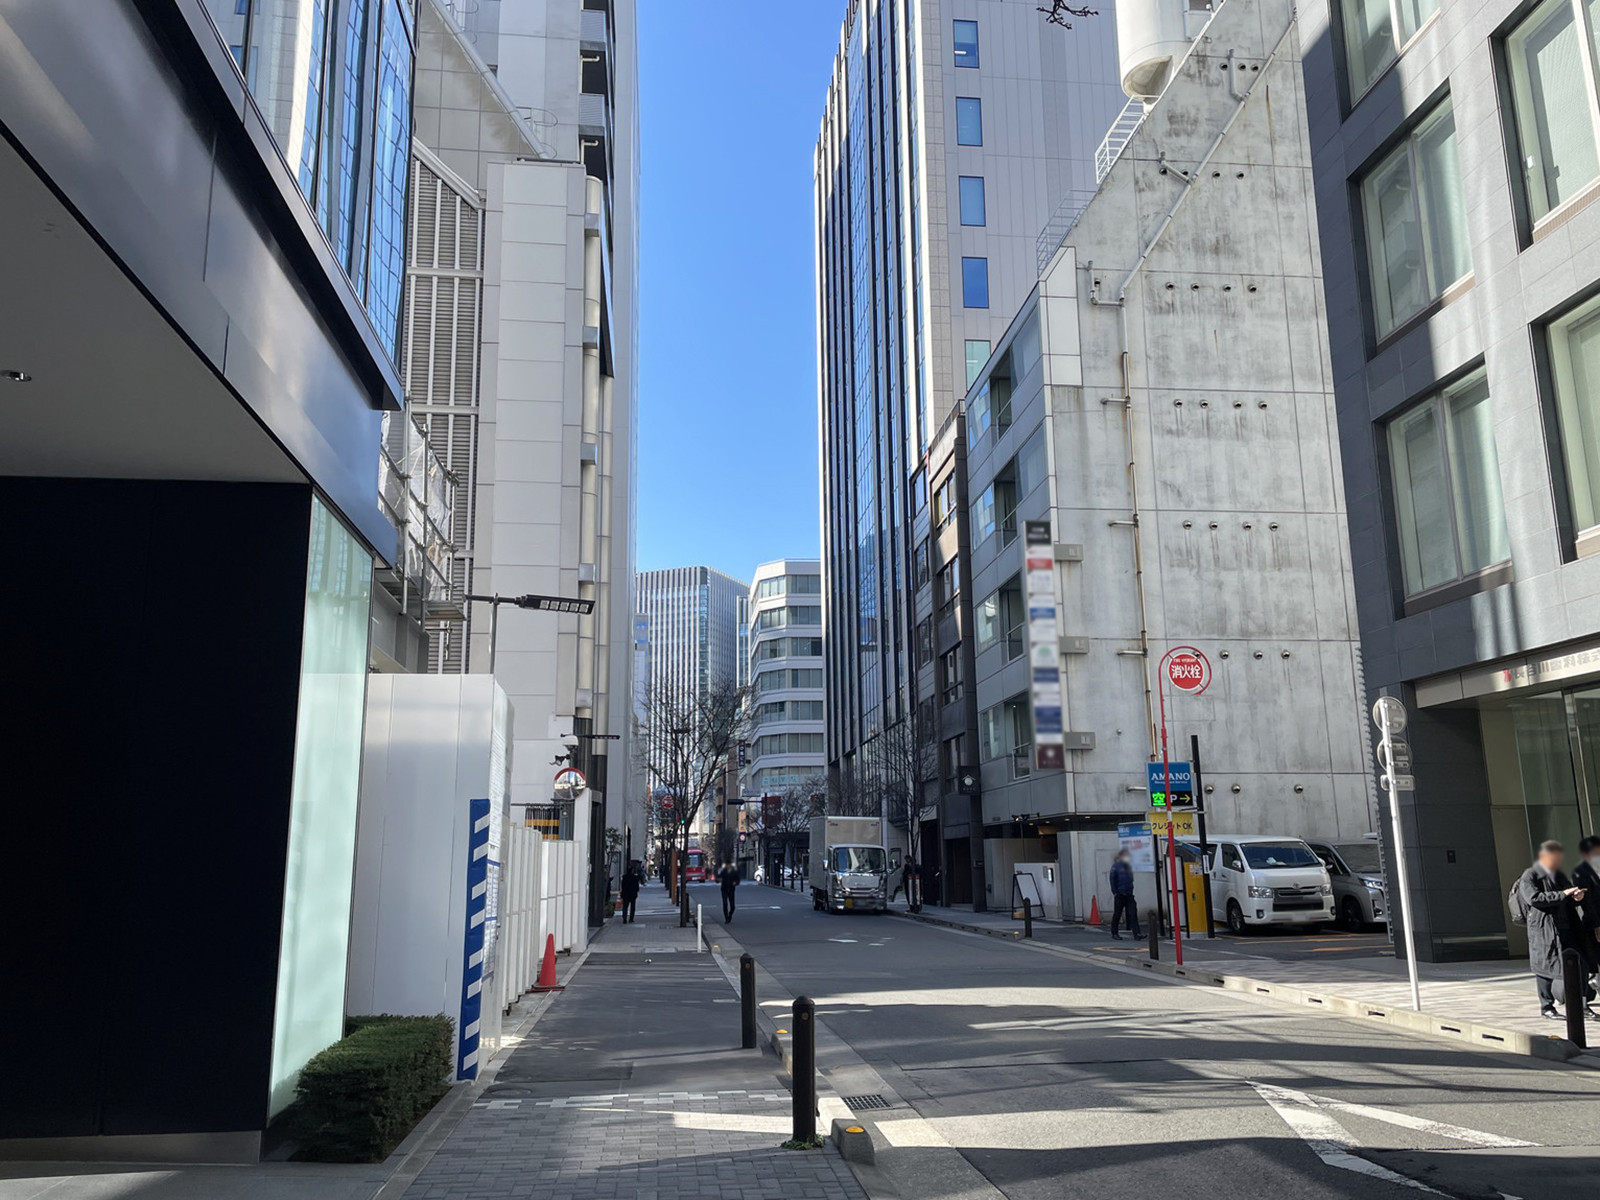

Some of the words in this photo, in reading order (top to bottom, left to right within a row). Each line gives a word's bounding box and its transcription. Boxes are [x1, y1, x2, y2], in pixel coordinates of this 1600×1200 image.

[1171, 664, 1201, 679] 消火栓
[1151, 772, 1190, 781] AMANO
[1152, 792, 1166, 806] 空
[1170, 794, 1178, 803] P
